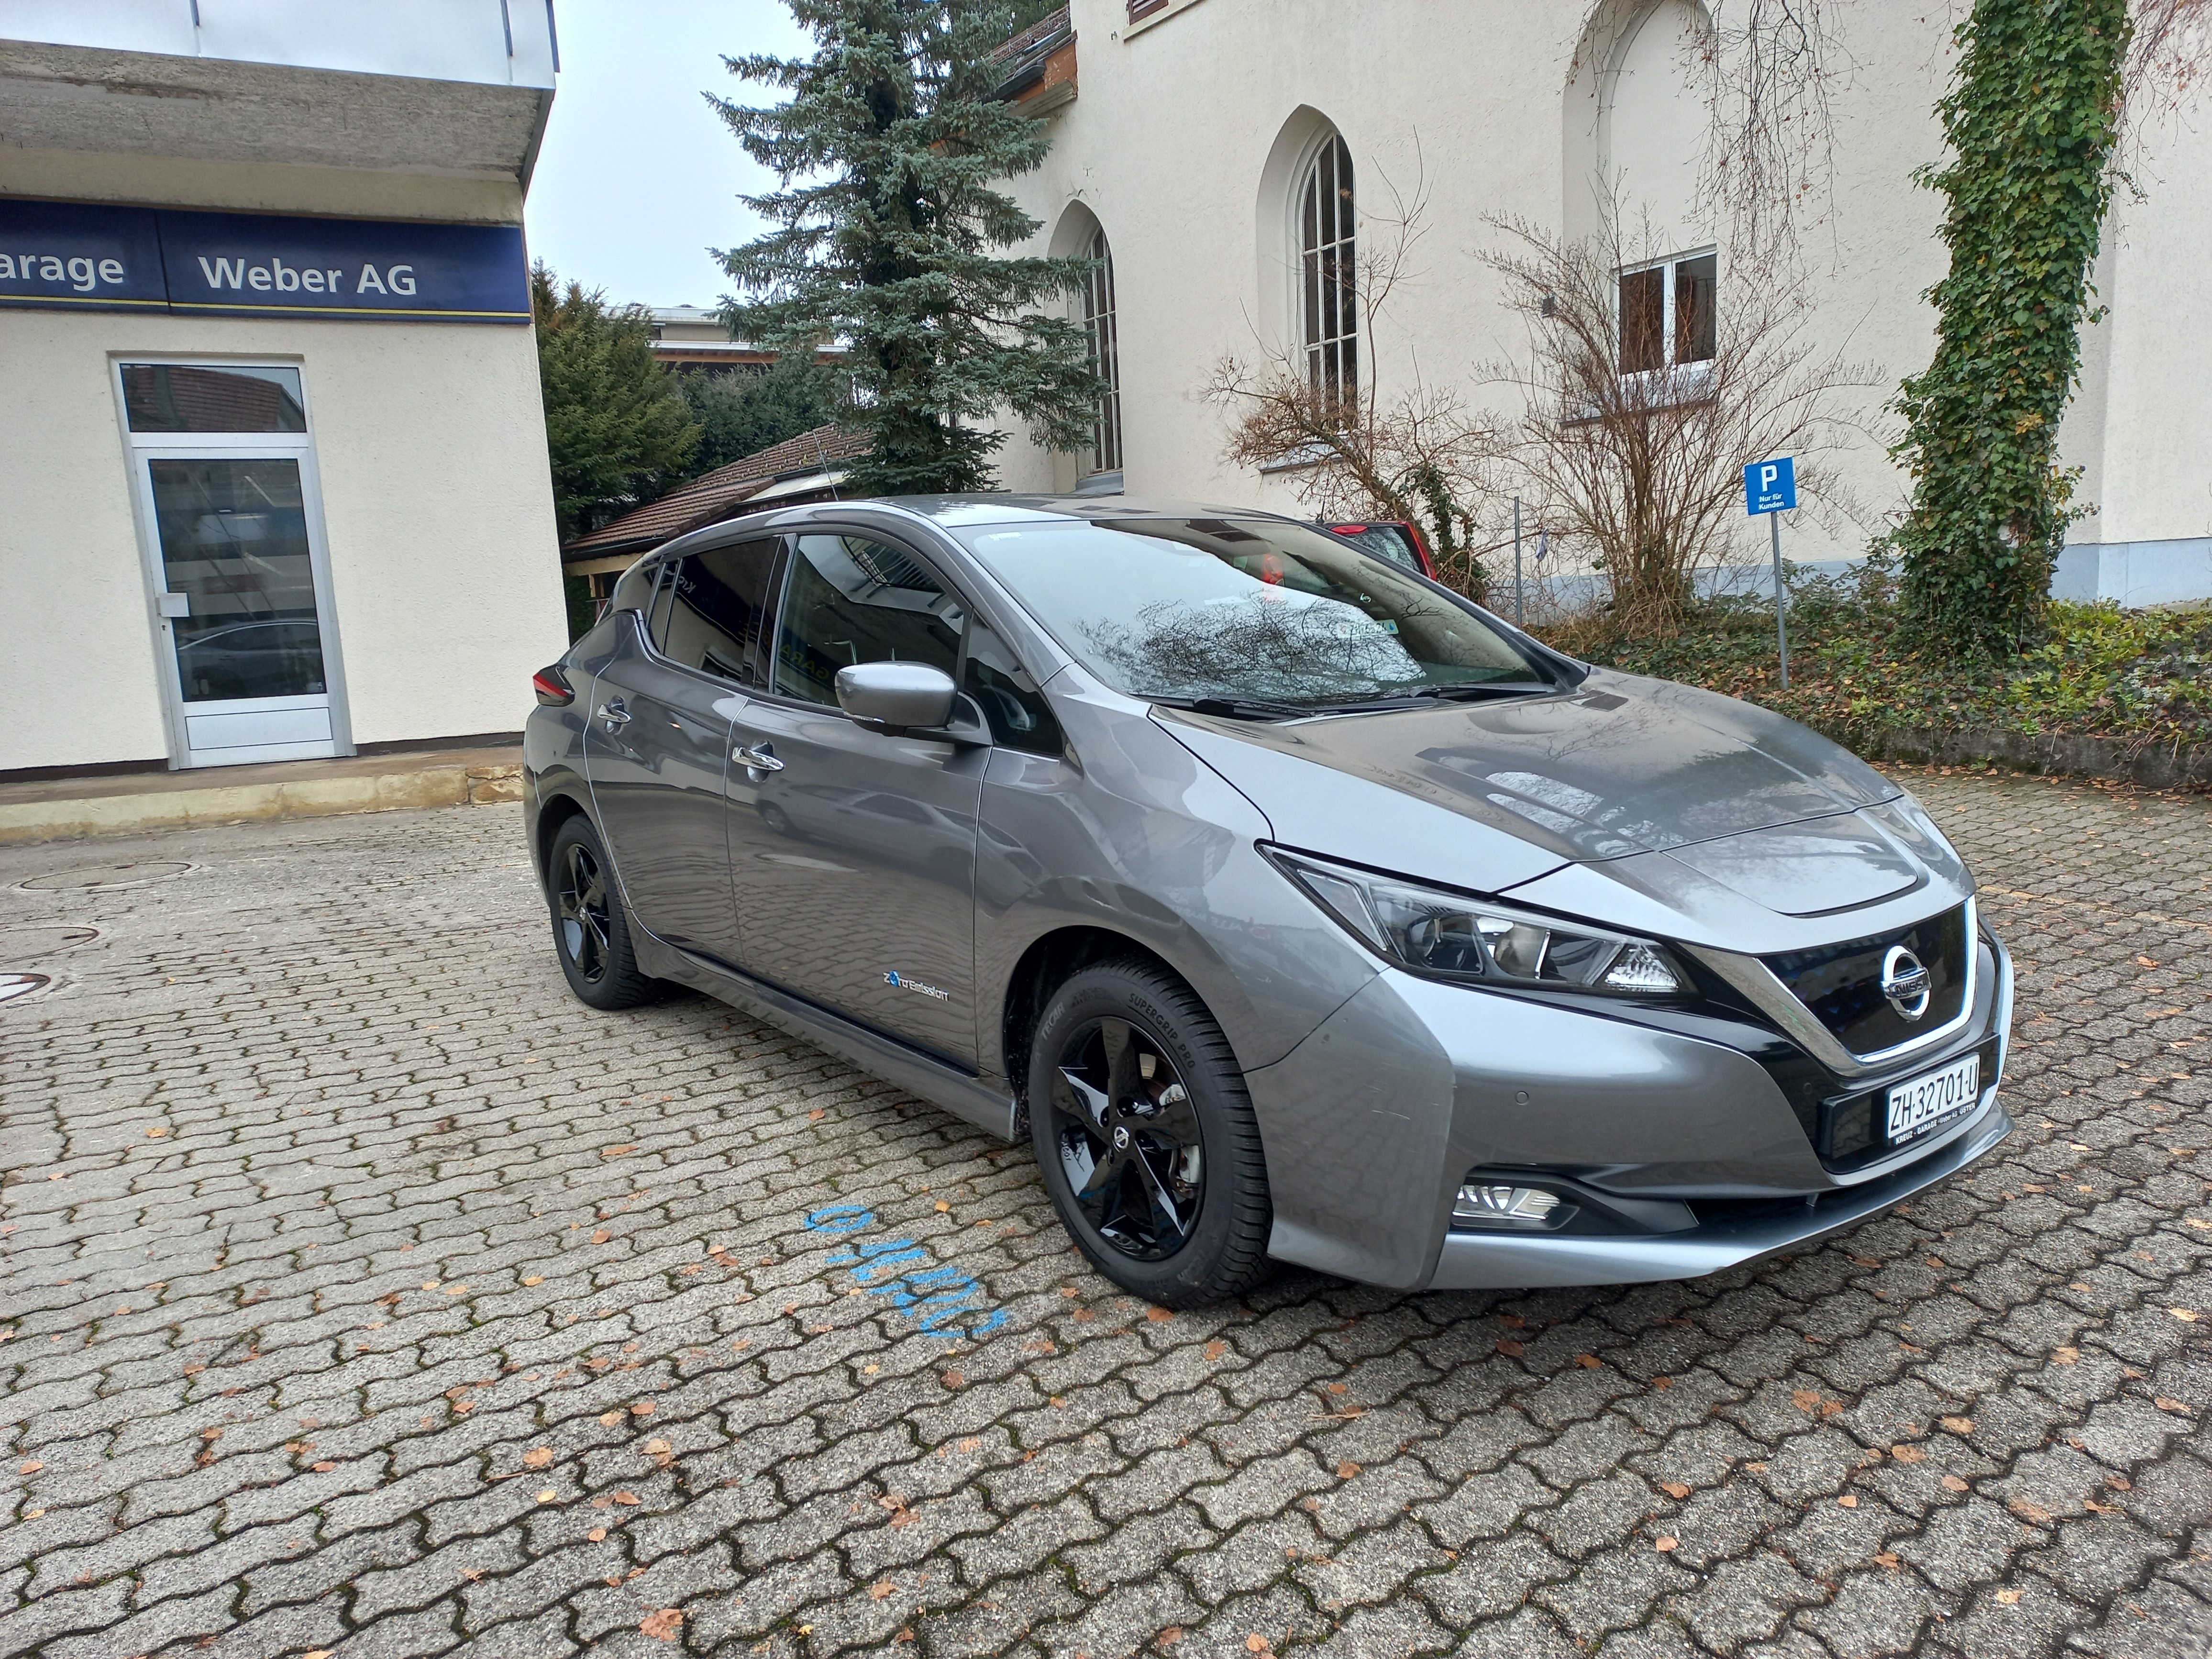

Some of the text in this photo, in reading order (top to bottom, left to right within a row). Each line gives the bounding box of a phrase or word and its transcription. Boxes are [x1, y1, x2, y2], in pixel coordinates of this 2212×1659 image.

[0, 253, 416, 295] arage Weber AG
[1761, 465, 1778, 492] P
[1759, 501, 1784, 510] Kunden
[909, 980, 949, 1002] Emission
[1129, 993, 1195, 1068] SUPERGRIP PRO
[1896, 1131, 1913, 1145] KREUZ
[1917, 1119, 1937, 1134] GARAGE
[1960, 1102, 1975, 1115] USTER
